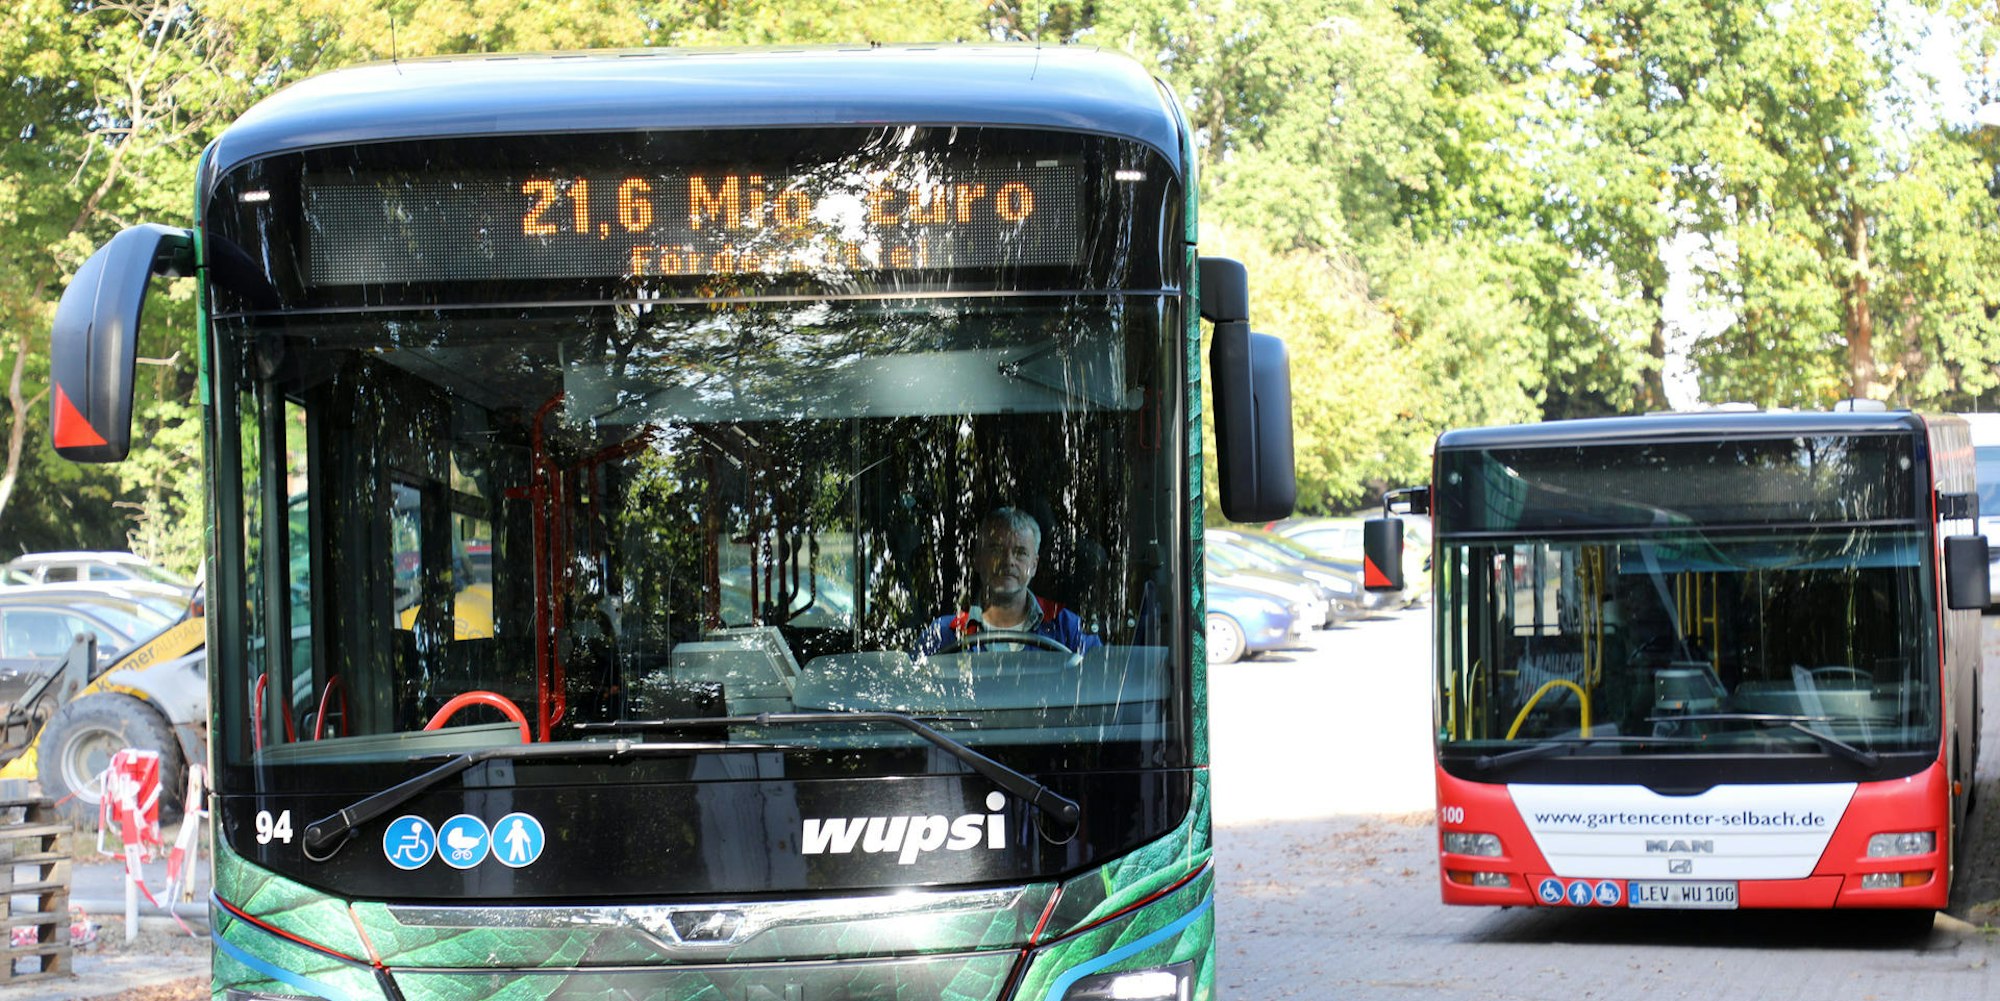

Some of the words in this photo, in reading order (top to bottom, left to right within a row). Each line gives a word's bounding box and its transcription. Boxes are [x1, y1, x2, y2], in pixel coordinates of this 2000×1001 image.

[521, 177, 653, 241] 21,6
[1441, 805, 1465, 824] 100
[1535, 810, 1826, 829] www.gartencenter-selbach.de
[255, 809, 294, 845] 94
[801, 790, 1006, 865] wupsi
[1645, 839, 1714, 854] MAN
[1640, 886, 1669, 902] LEV
[1681, 886, 1701, 902] WU
[1705, 886, 1734, 902] 100
